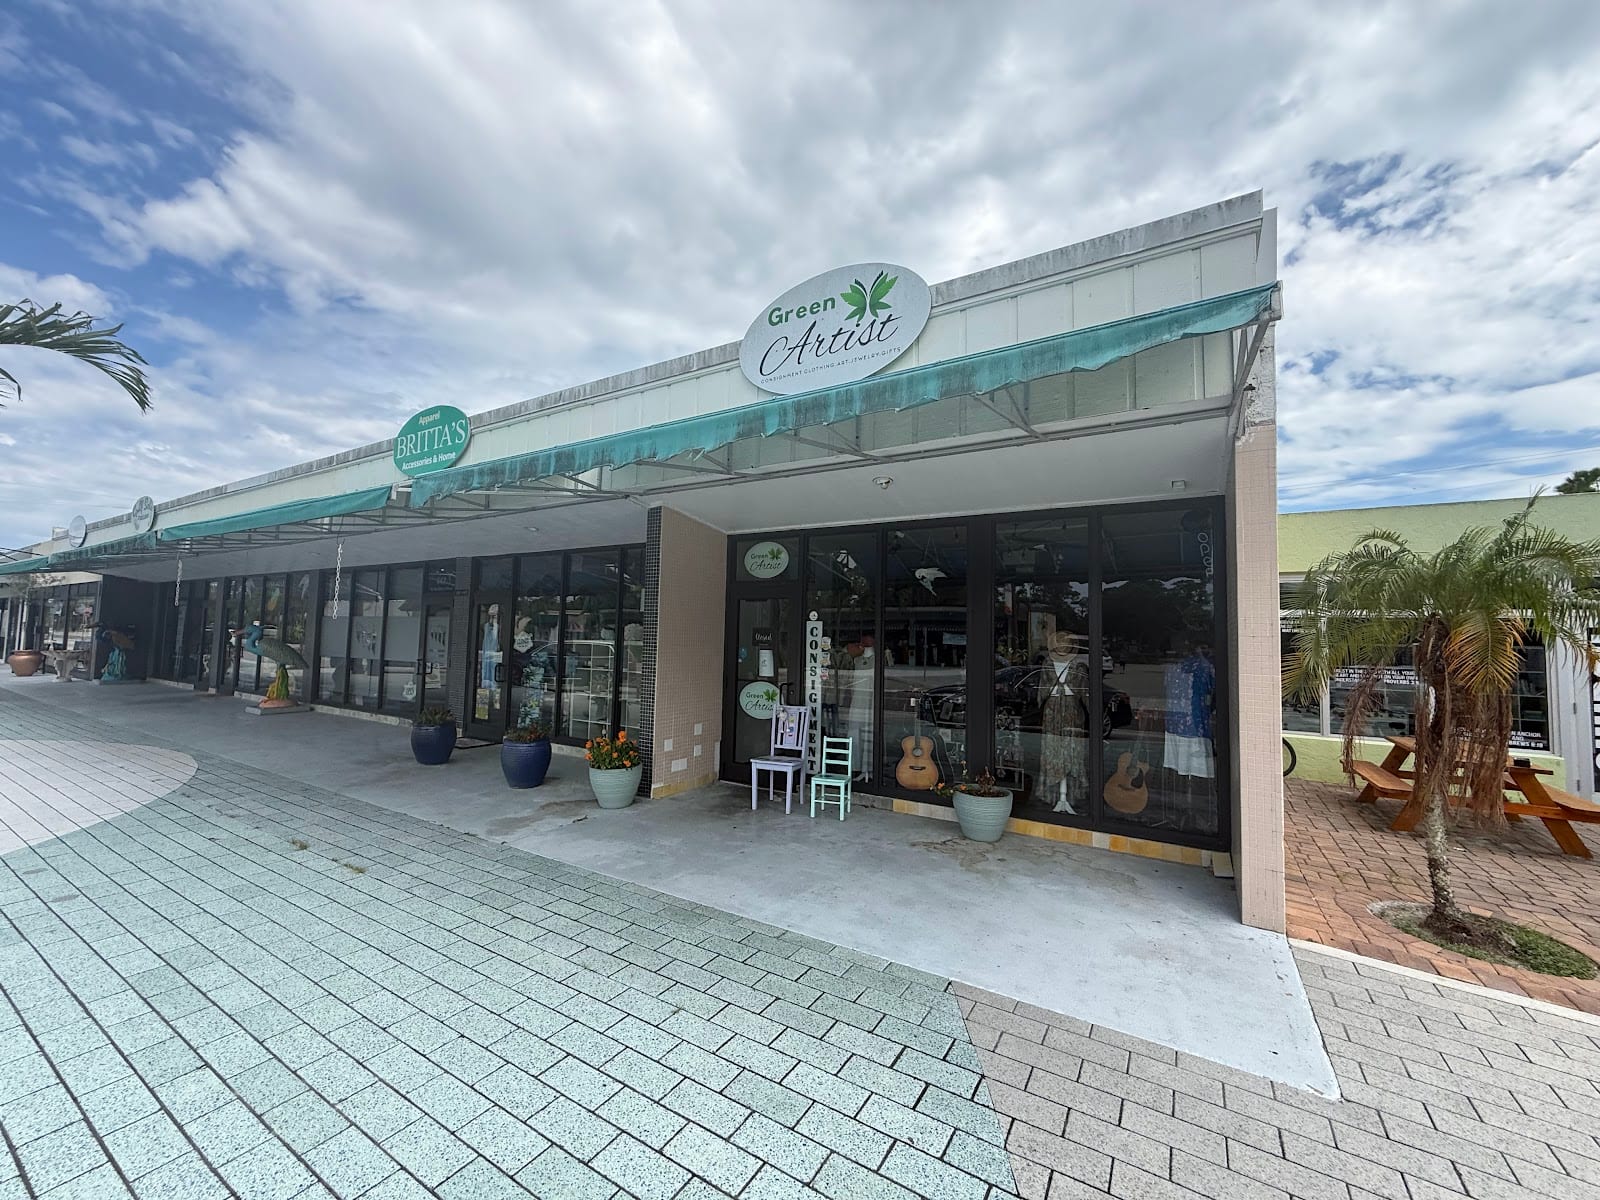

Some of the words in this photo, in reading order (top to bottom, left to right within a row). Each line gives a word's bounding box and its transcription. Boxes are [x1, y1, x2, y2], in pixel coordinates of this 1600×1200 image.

[767, 296, 837, 327] Green
[759, 313, 903, 377] Artist
[760, 370, 802, 384] CONSIGNMENT
[418, 410, 441, 426] Apparel
[396, 419, 466, 459] BRITTA'S
[401, 456, 433, 471] Accessories
[432, 454, 438, 463] &
[438, 451, 456, 462] Home
[749, 559, 782, 571] Artist
[745, 691, 764, 699] Green
[808, 626, 819, 771] CONSIGNMENT
[745, 699, 774, 711] Artis
